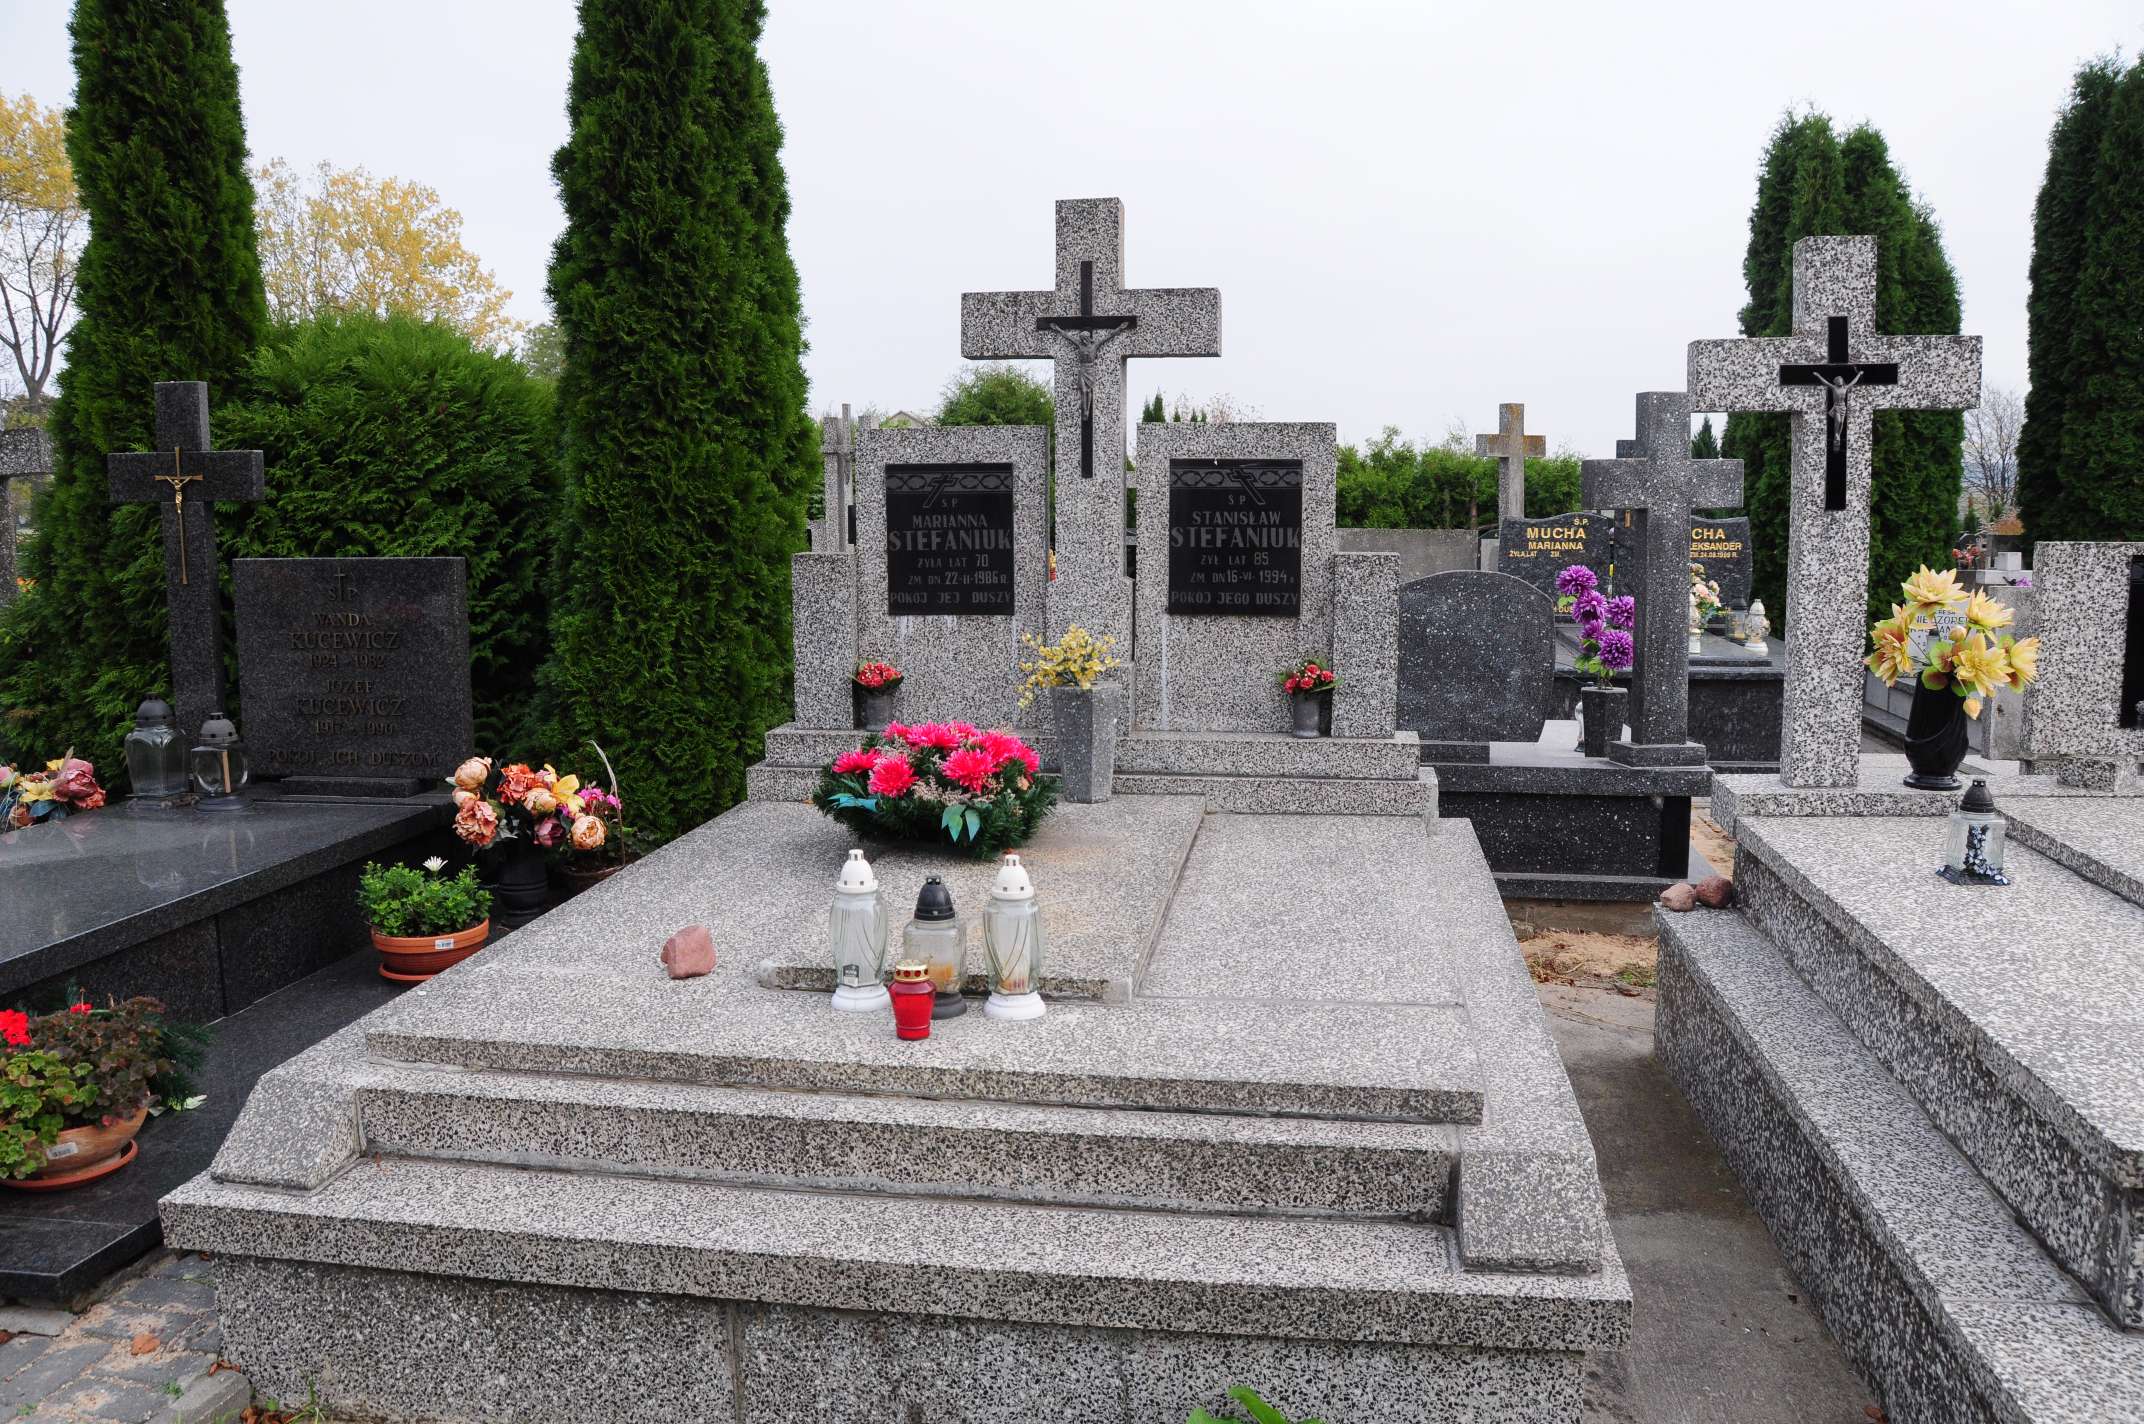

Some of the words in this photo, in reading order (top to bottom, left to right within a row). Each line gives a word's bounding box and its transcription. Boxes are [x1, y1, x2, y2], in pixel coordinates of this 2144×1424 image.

[912, 514, 988, 528] MARIANNA
[1192, 511, 1281, 525] STANISŁAW
[888, 529, 1012, 551] STEFANIUK
[1170, 526, 1301, 549] STEFANIUK
[1526, 527, 1586, 539] MUCHA
[1691, 528, 1726, 540] CHA
[1528, 541, 1584, 550] MARIANNA
[975, 553, 989, 567] 70
[1228, 555, 1247, 566] LAT
[1253, 551, 1269, 566] 85
[936, 592, 960, 604] JEJ
[972, 592, 1011, 604] DUSZY
[1216, 592, 1250, 605] JEGO
[1255, 593, 1298, 605] DUSZY
[289, 631, 401, 650] KUCEWICZ
[296, 698, 405, 716] KUCEWICZ
